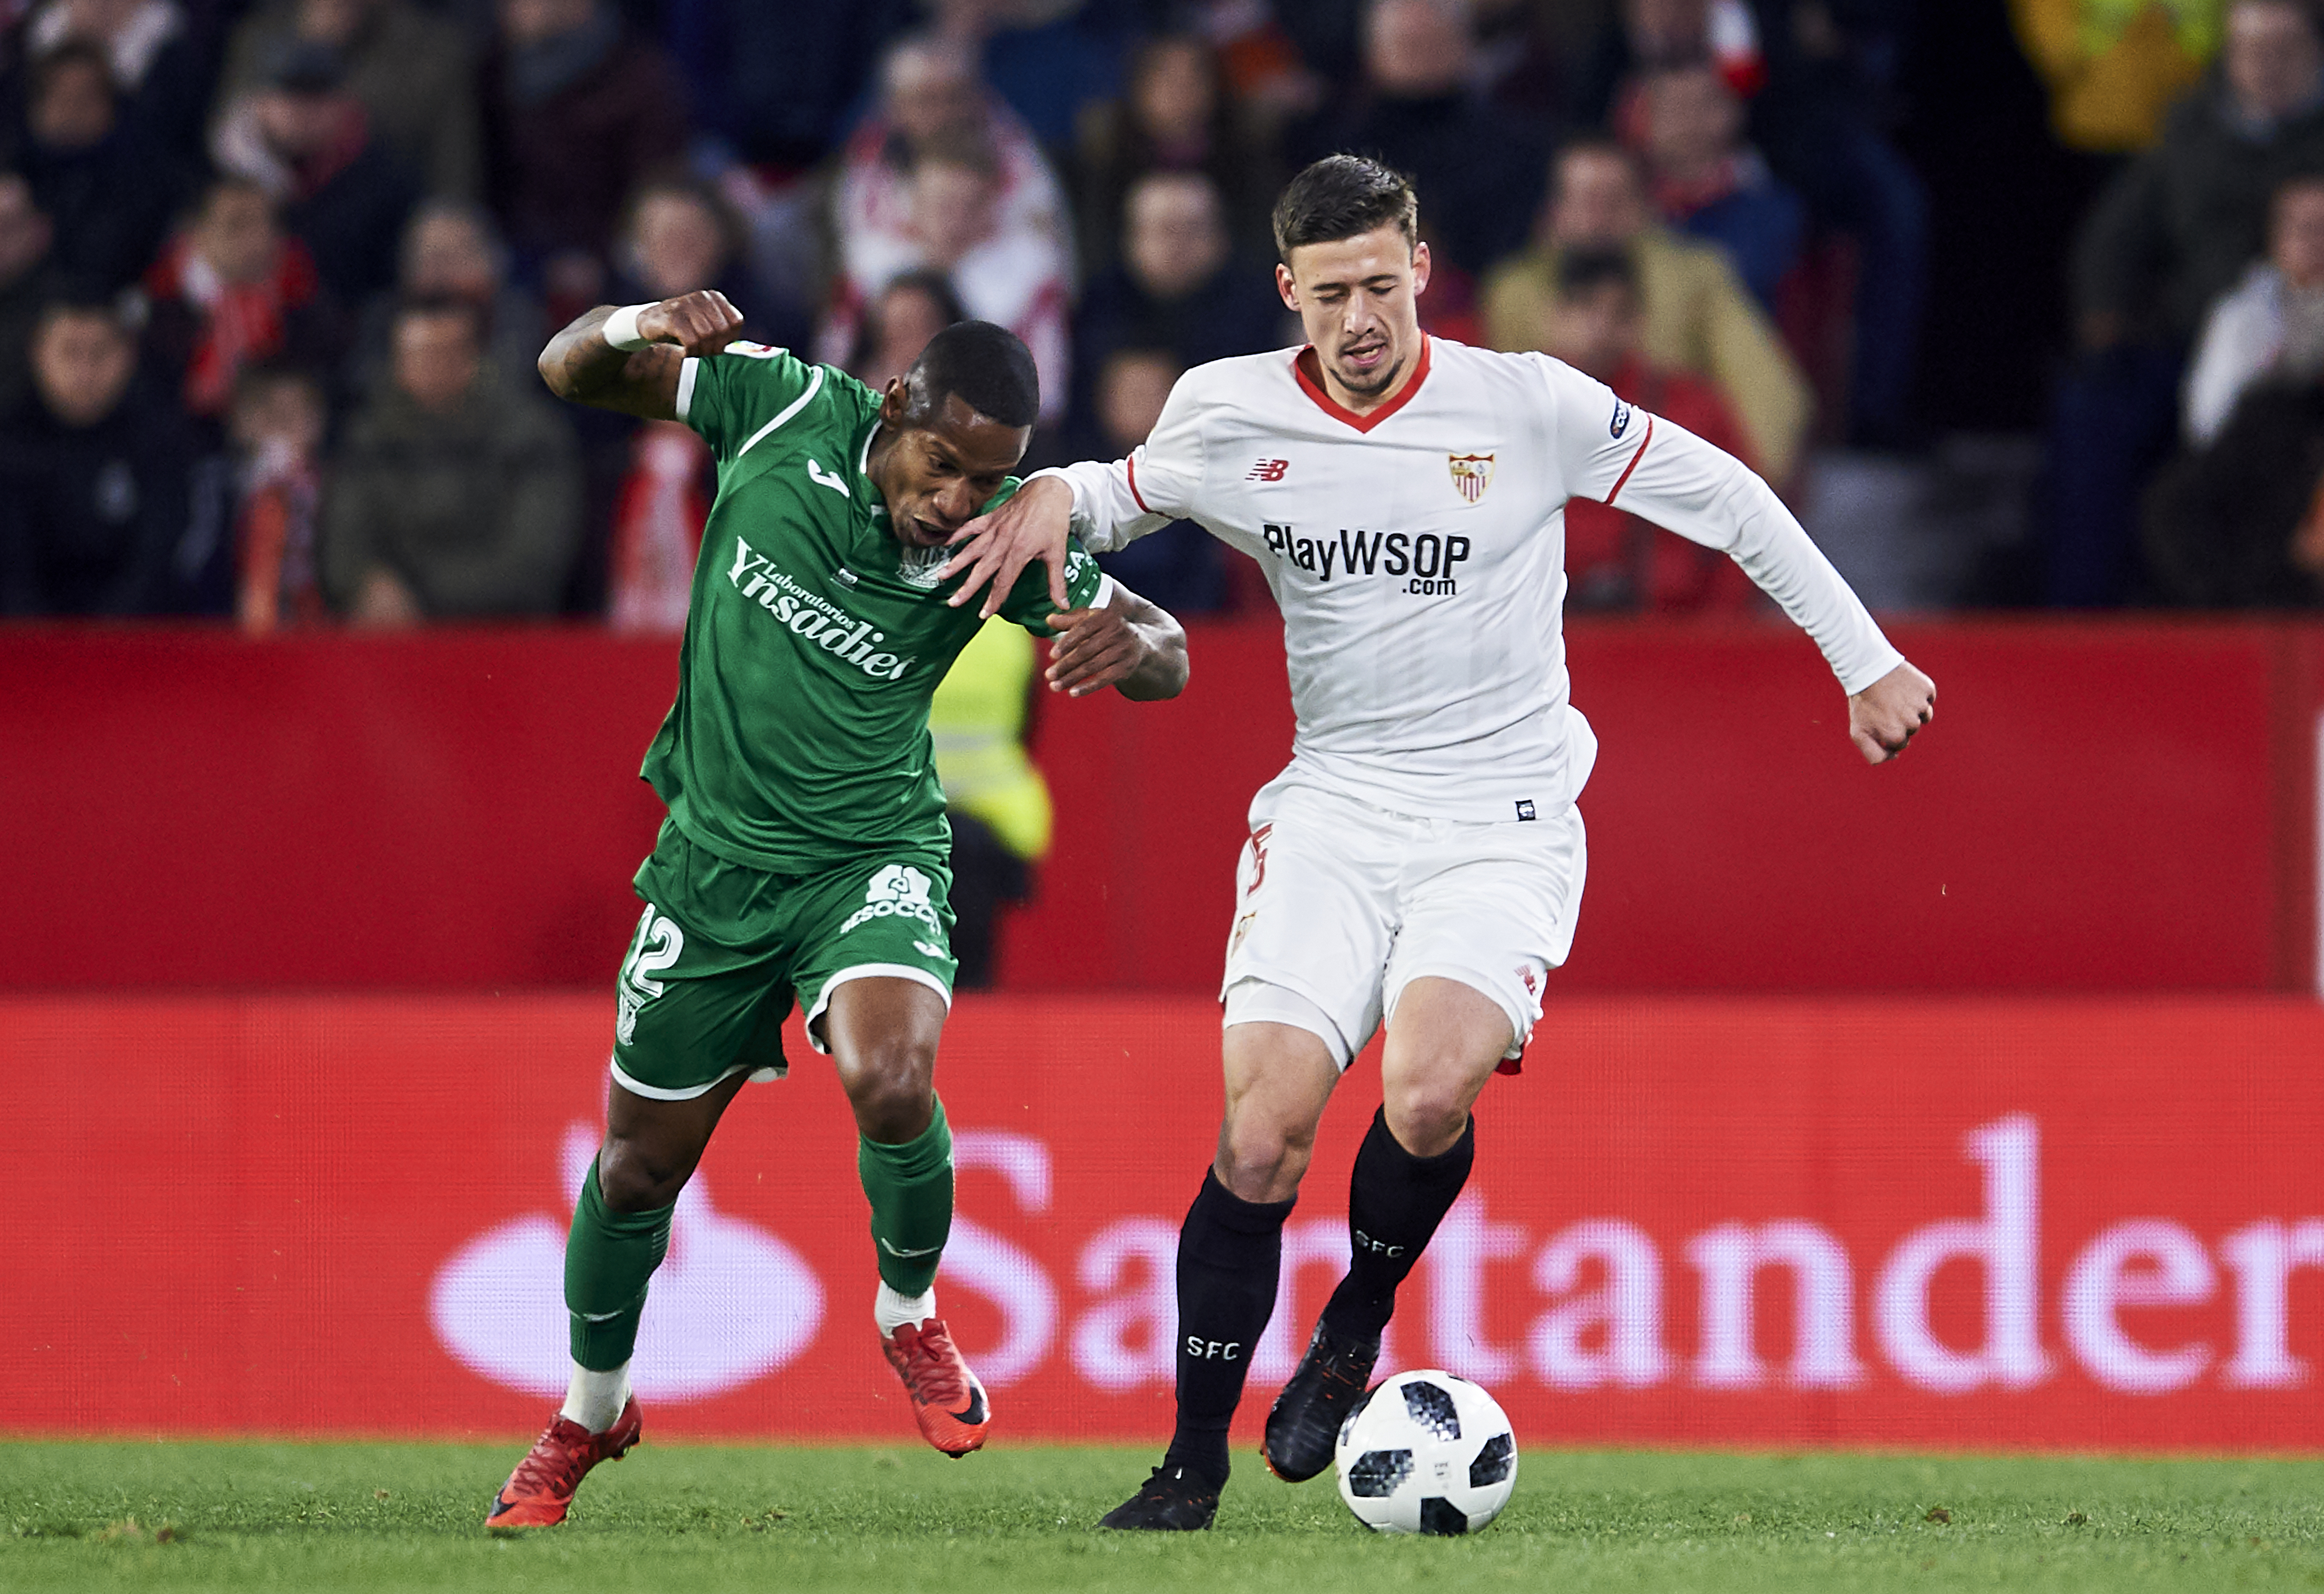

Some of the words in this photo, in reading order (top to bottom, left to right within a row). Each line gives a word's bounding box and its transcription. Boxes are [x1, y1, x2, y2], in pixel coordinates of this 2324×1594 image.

[1264, 524, 1470, 582] PlayWSOP
[762, 563, 856, 629] Laboratorios
[1402, 578, 1456, 595] .com
[626, 902, 684, 999] 12
[890, 1112, 2324, 1393] Santander
[1355, 1229, 1405, 1258] SFC
[1187, 1336, 1241, 1361] SFC
